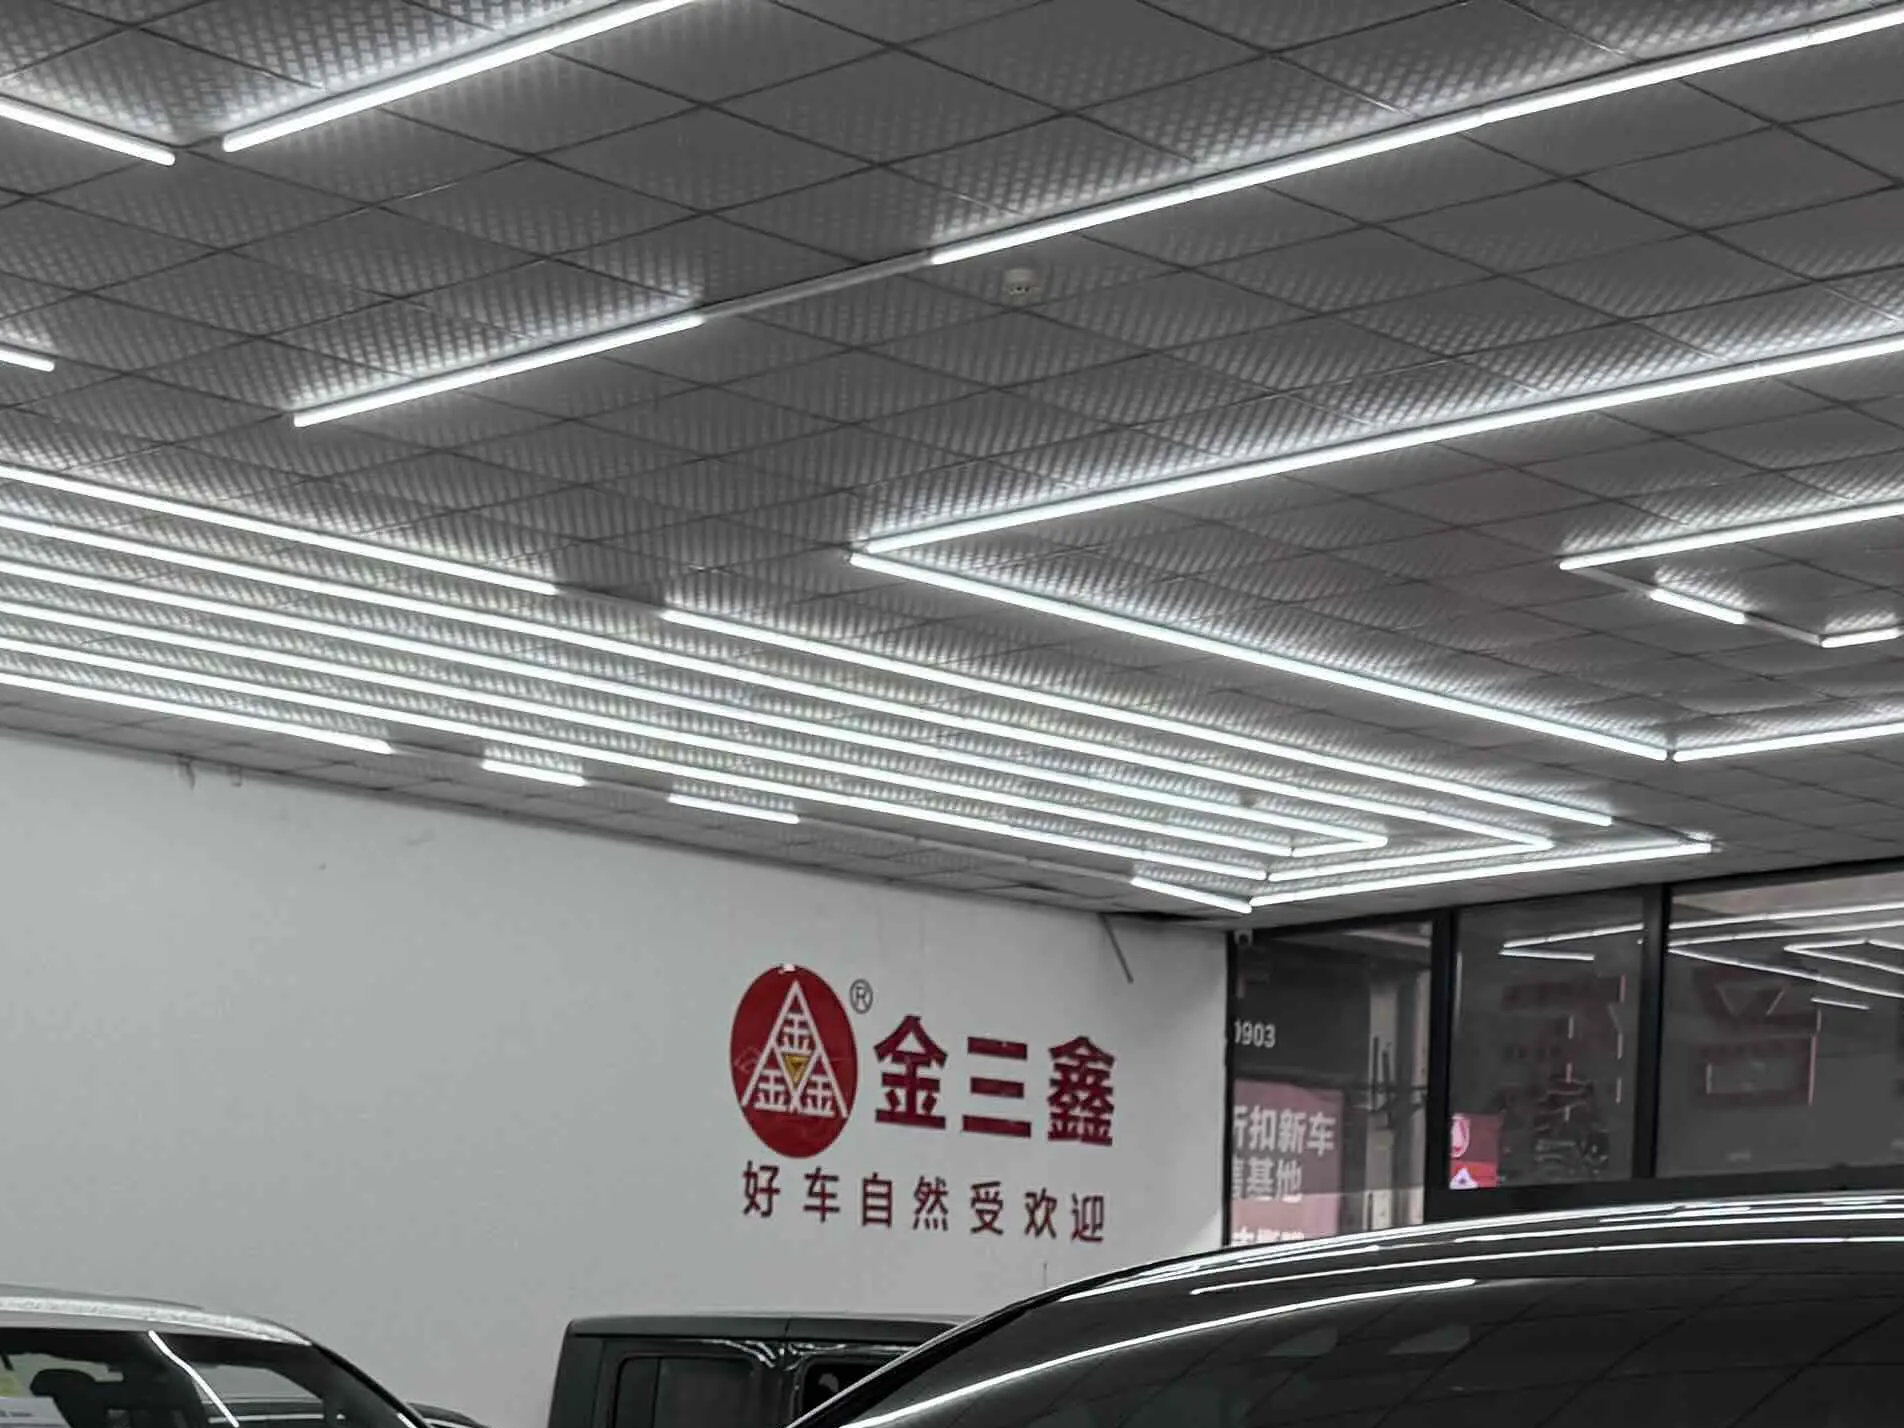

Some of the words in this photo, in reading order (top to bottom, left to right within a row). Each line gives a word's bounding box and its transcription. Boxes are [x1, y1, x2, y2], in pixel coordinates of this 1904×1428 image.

[874, 1014, 1115, 1147] 金三鑫
[741, 1160, 1106, 1244] 好车自然受欢迎
